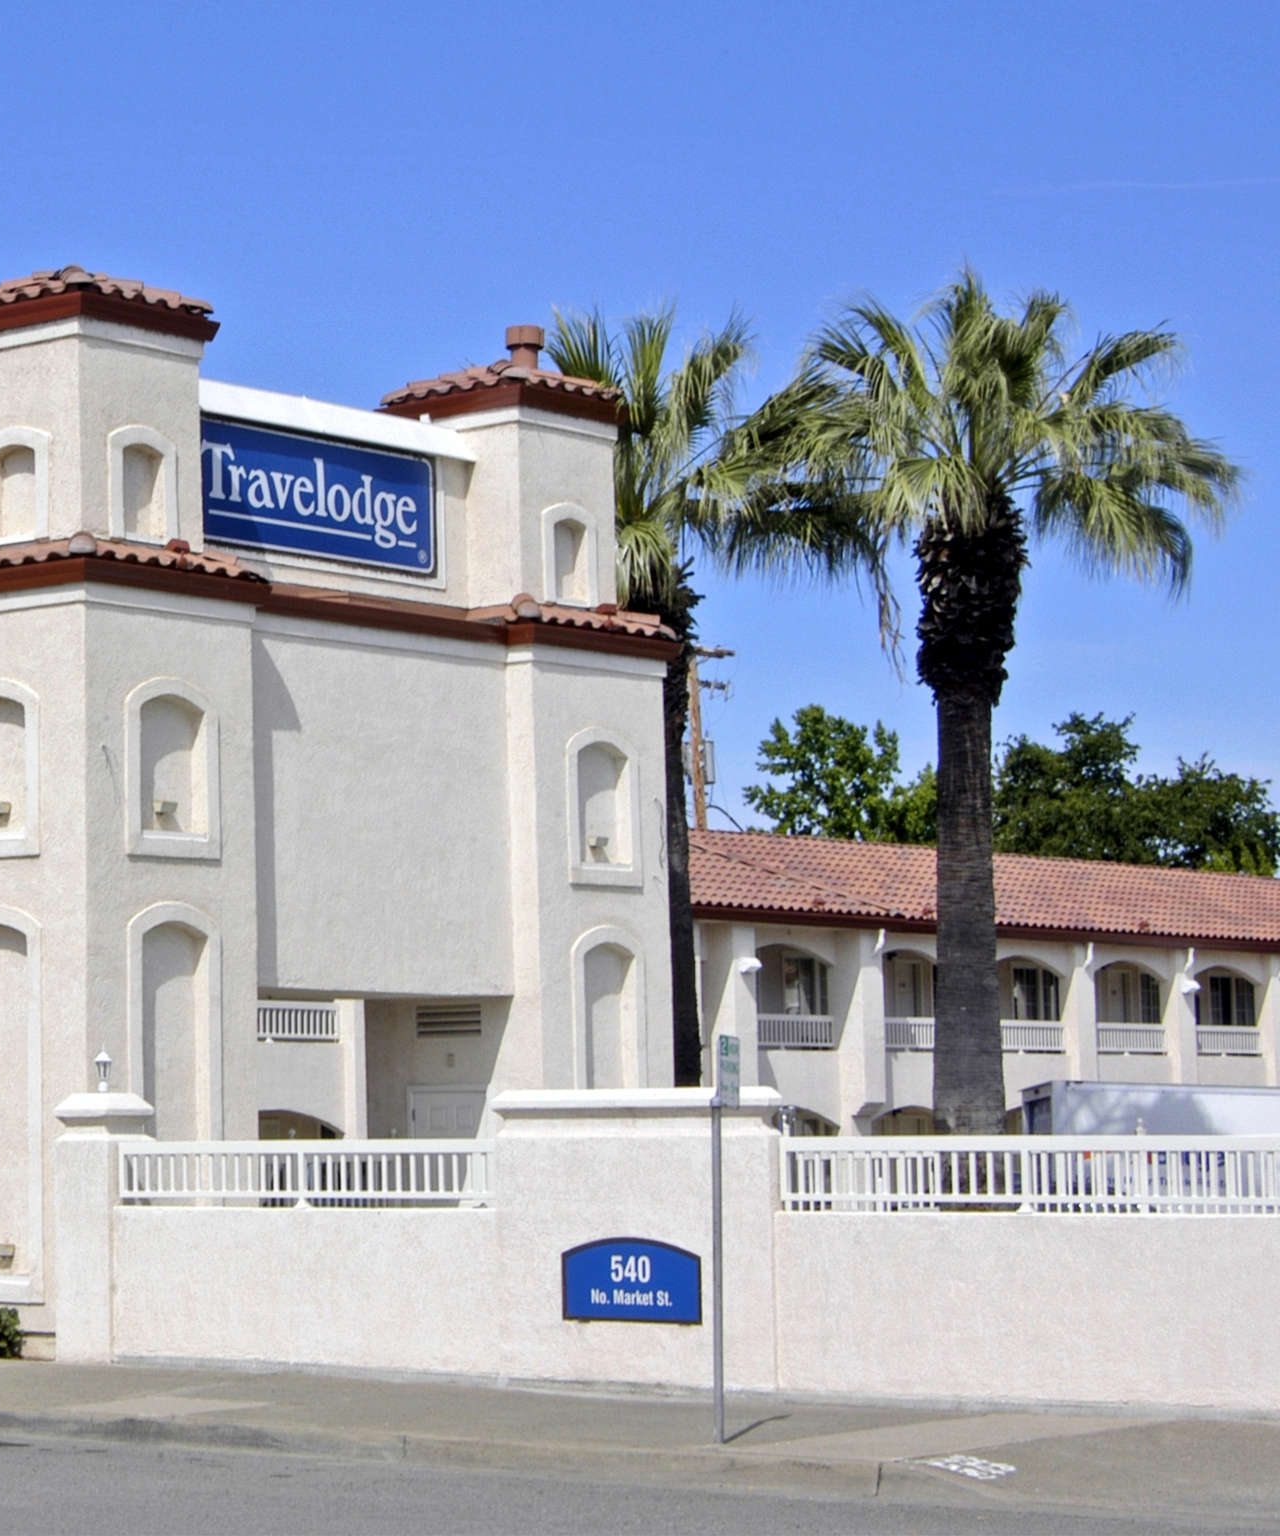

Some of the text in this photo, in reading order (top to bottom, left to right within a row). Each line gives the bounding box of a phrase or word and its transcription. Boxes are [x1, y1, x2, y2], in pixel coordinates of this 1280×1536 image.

[201, 440, 417, 548] Travelodge
[610, 1255, 651, 1283] 540
[590, 1288, 673, 1307] No. Market St.
